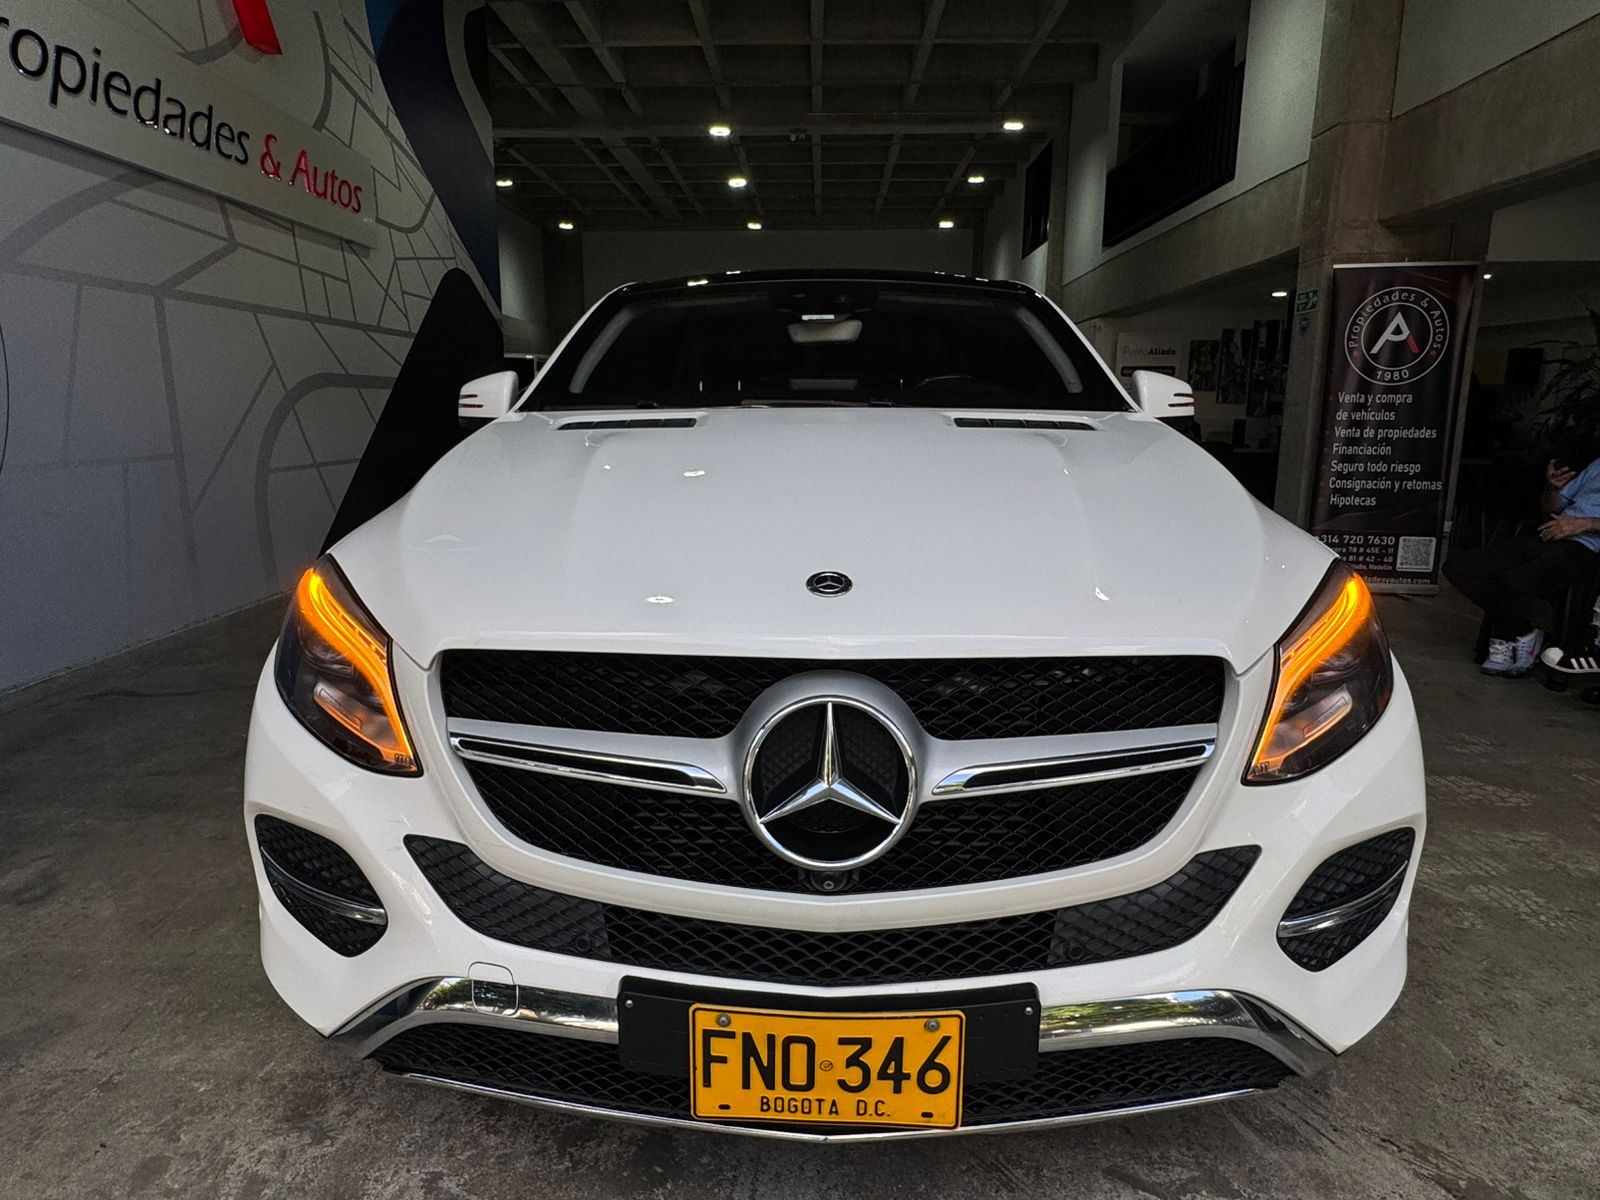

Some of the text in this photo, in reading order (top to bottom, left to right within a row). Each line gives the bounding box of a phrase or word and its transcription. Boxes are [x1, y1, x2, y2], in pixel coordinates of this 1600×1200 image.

[260, 134, 281, 181] &
[290, 150, 363, 213] Autos
[1349, 291, 1445, 349] Propiedades & Autos
[1376, 369, 1410, 381] 1980
[1338, 392, 1413, 406] Venta y compra
[1336, 408, 1396, 420] de vehículos
[1335, 426, 1437, 440] Venta de propiedades
[1333, 442, 1392, 455] Financiación
[1330, 460, 1421, 475] Seguro todo riesgo
[1329, 477, 1442, 492] Consignación y retomas
[1330, 494, 1377, 508] Hipotecas
[1321, 535, 1395, 545] 314 720 7630
[702, 1028, 952, 1095] FNO 346
[760, 1096, 892, 1117] BOGOTA D.C.
